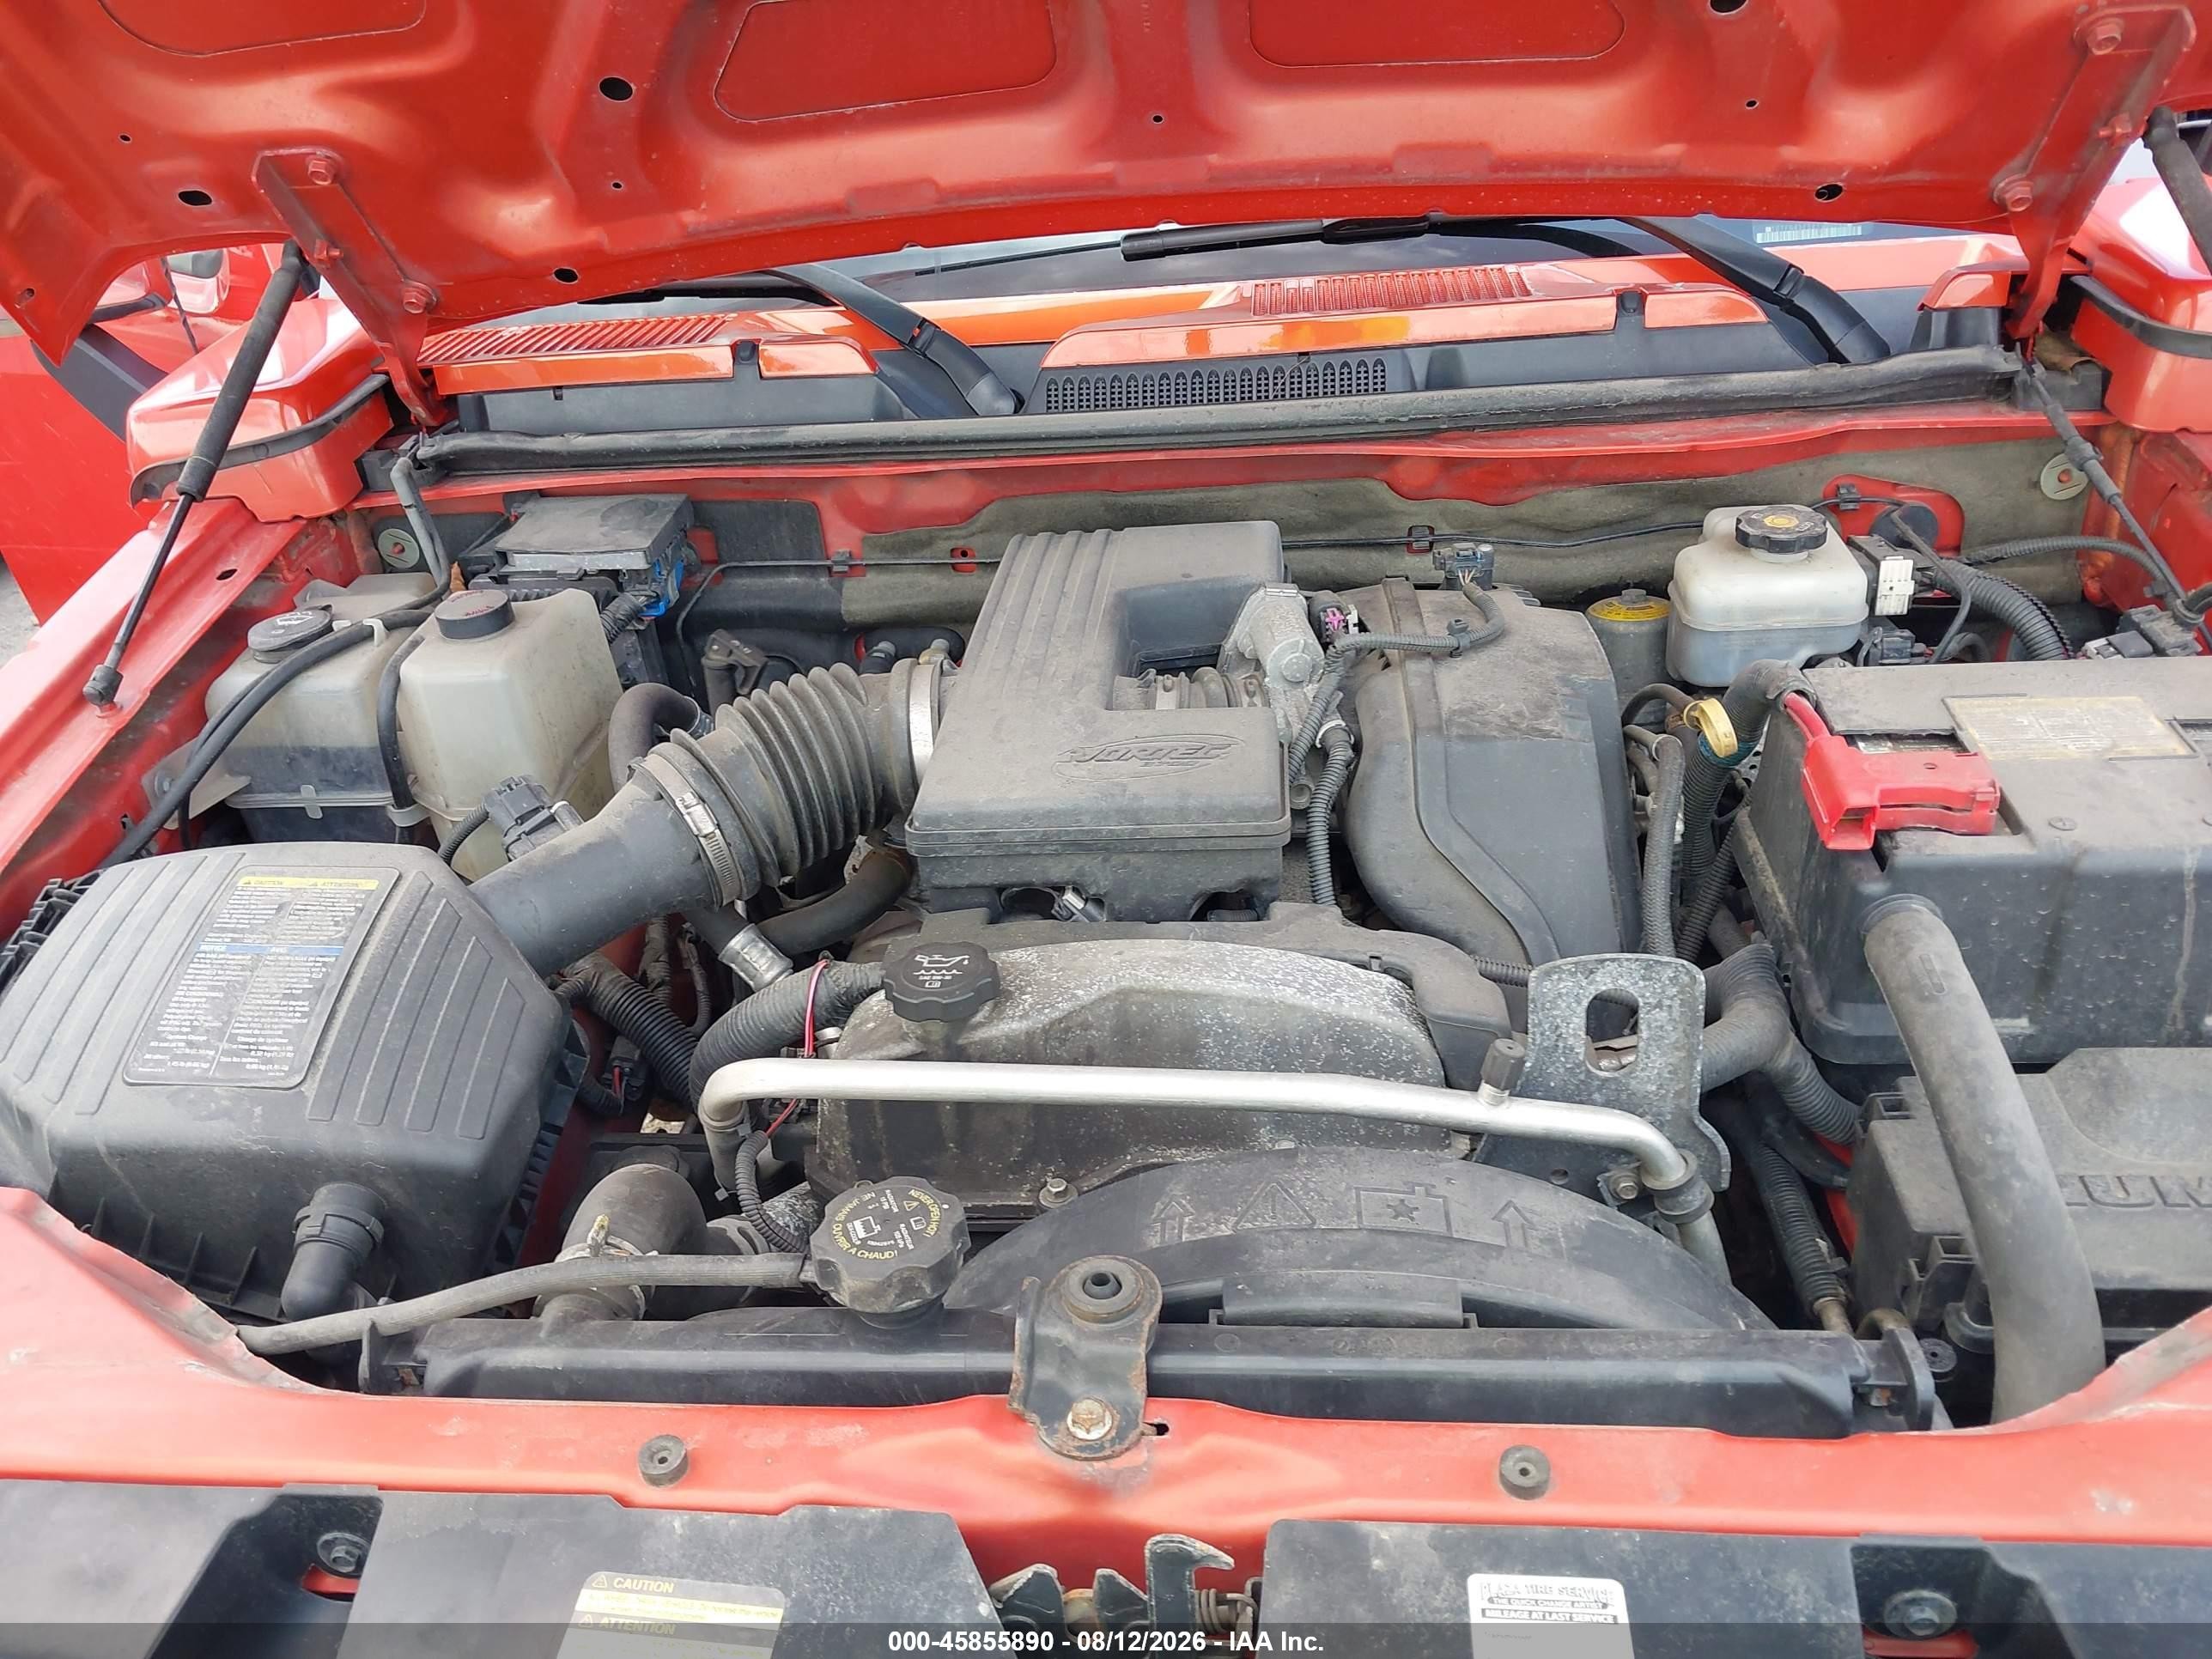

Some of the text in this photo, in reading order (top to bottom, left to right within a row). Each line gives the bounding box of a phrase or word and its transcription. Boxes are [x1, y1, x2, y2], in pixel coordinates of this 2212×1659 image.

[861, 1191, 877, 1202] NE
[908, 1188, 931, 1206] NEVER
[928, 1203, 942, 1221] OPEN
[835, 1198, 860, 1222] JAMAIS
[832, 1222, 852, 1251] OUVRIR
[613, 1577, 675, 1594] CAUTION
[599, 1615, 677, 1636] ATTENTION
[1485, 1609, 1614, 1624] MILEAGE AT LAST SERVICE
